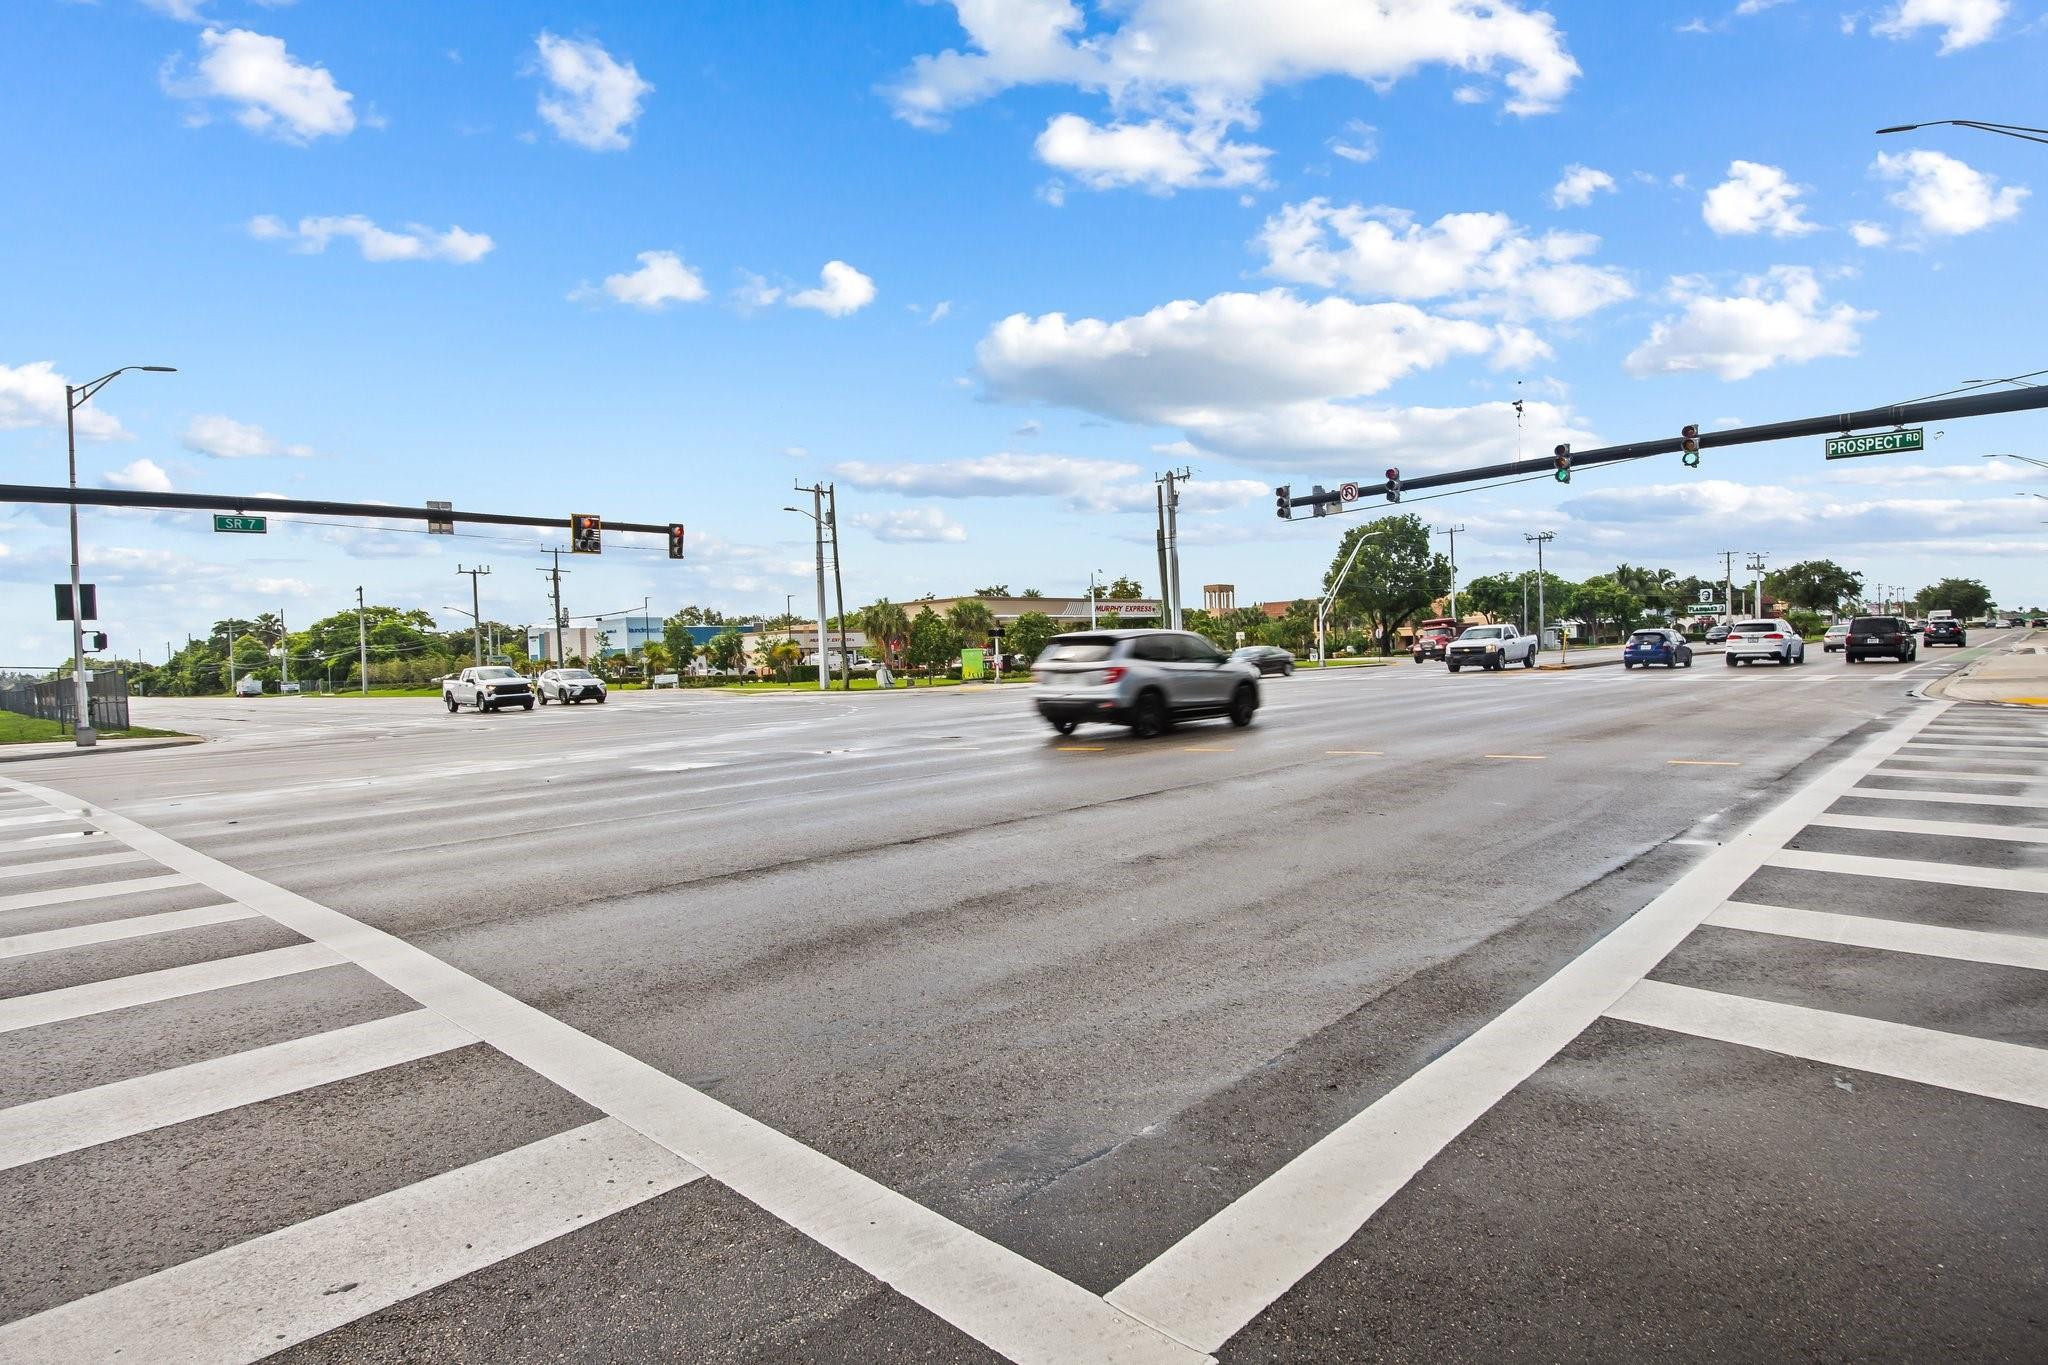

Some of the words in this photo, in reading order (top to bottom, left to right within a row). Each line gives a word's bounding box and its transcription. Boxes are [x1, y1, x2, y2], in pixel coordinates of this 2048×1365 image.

[1829, 435, 1902, 454] PROSPECT
[1906, 433, 1919, 442] RD
[225, 518, 242, 529] SR
[248, 519, 256, 529] 7
